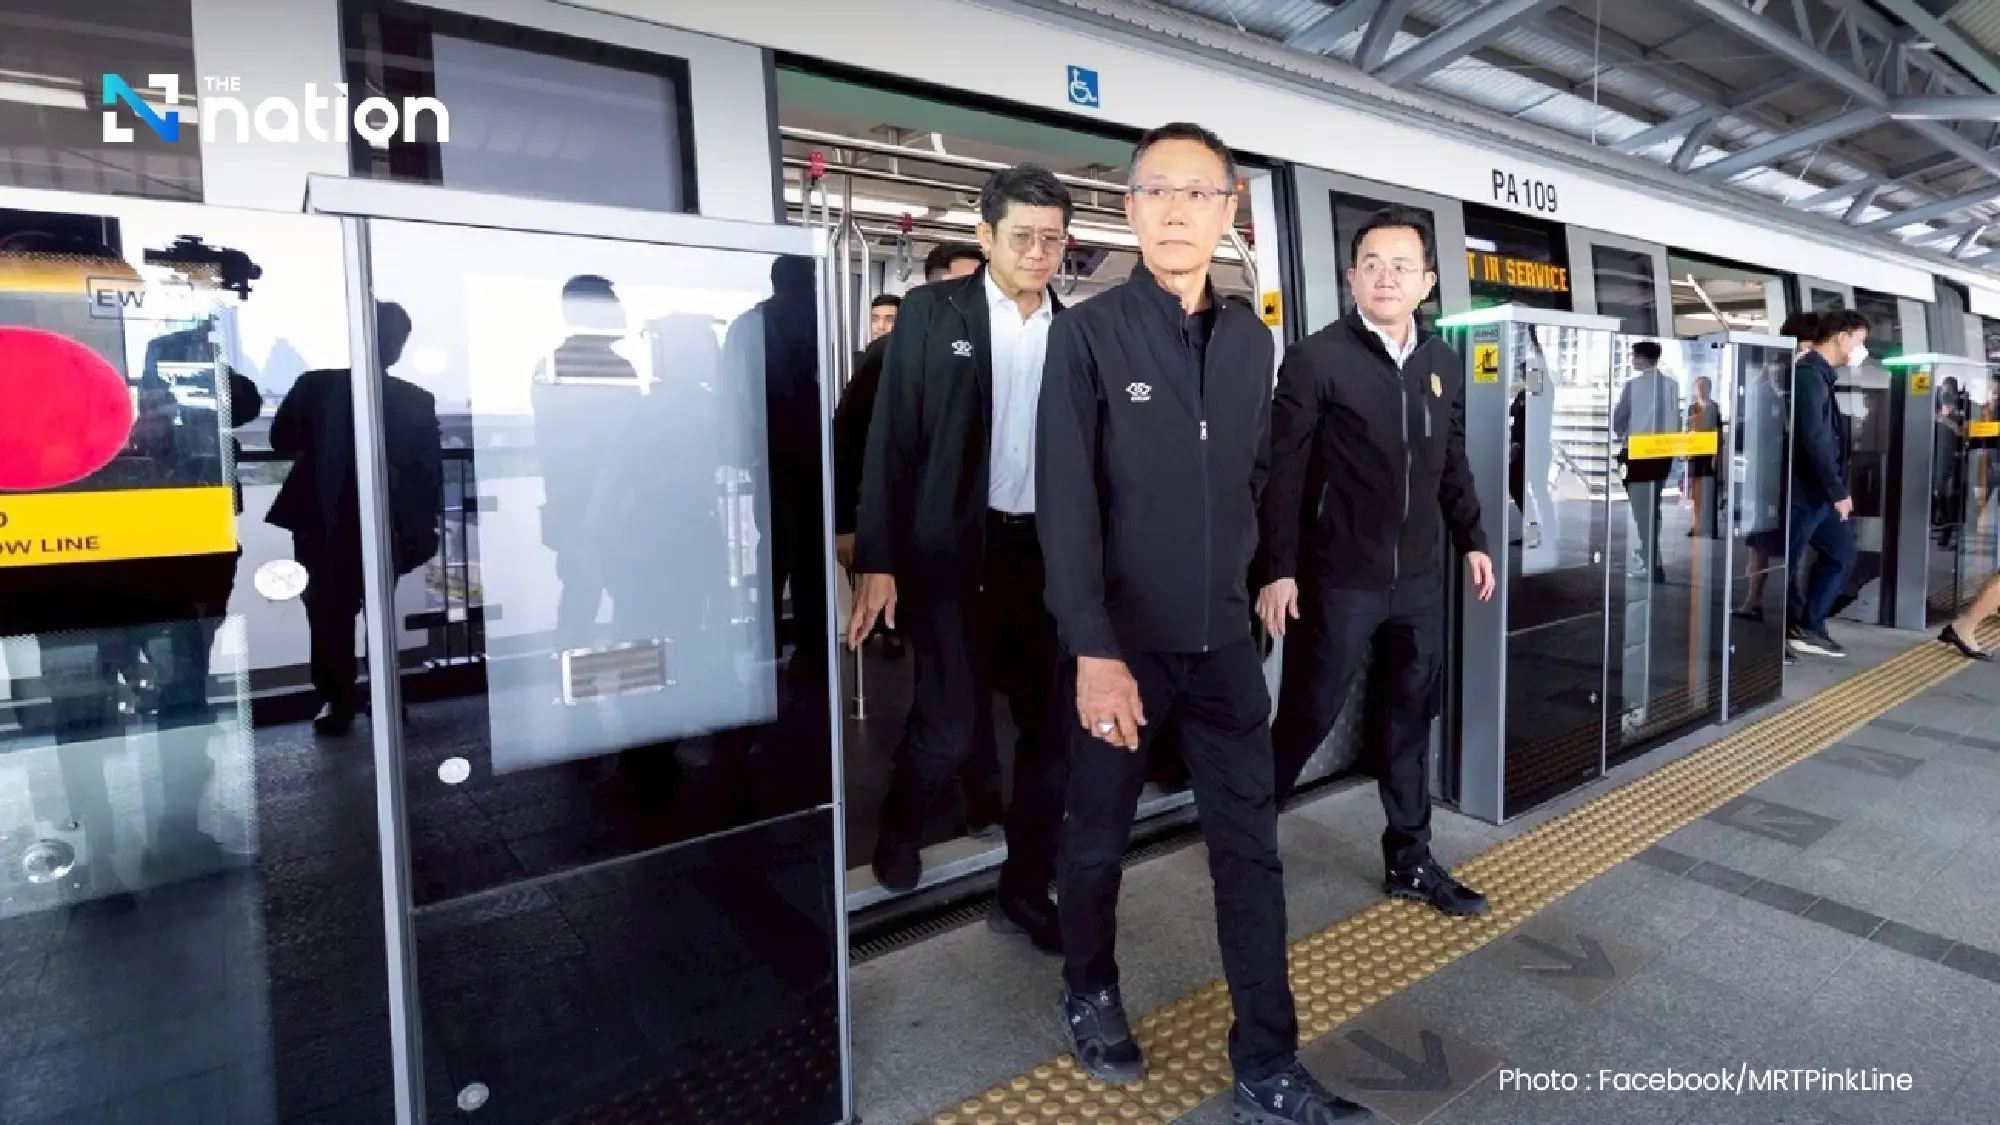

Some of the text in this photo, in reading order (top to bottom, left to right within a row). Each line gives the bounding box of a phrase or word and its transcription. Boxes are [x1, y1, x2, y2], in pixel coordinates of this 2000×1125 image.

[1484, 254, 1500, 281] IN
[1506, 258, 1569, 292] SERVICE
[41, 535, 100, 553] LINE
